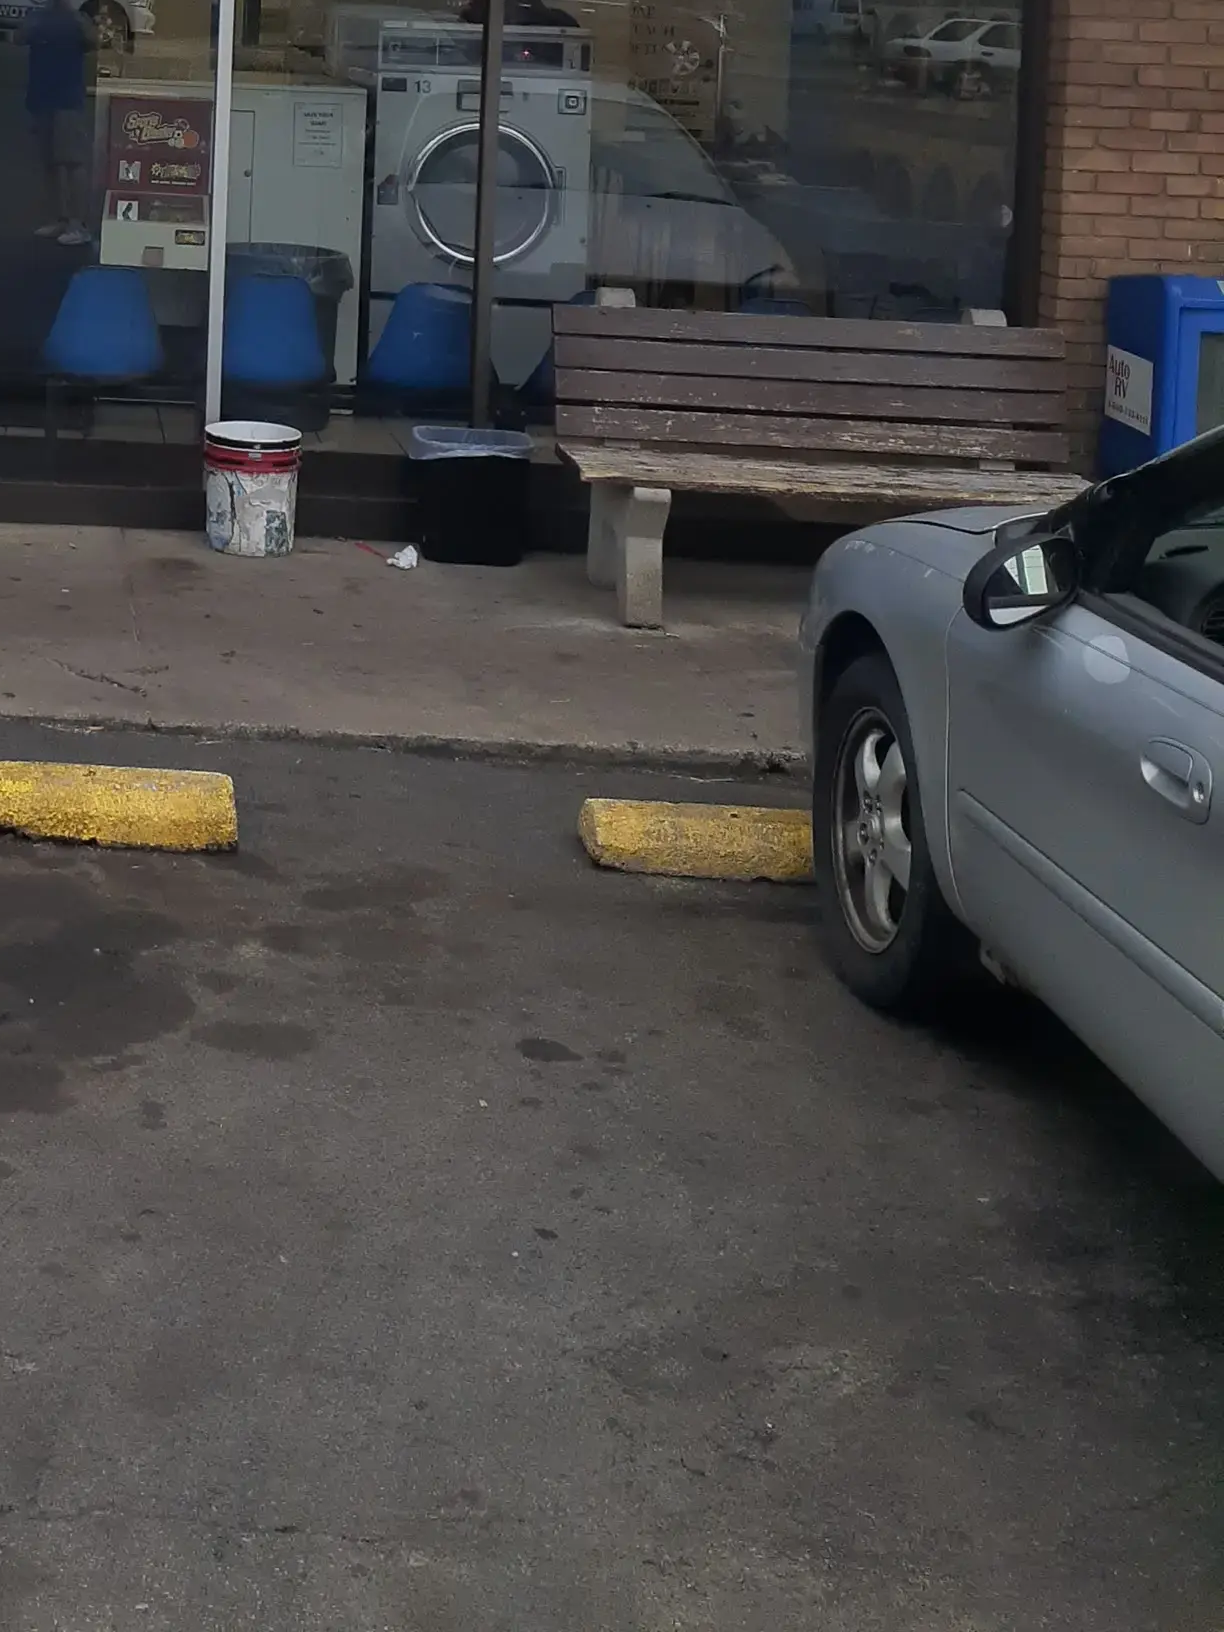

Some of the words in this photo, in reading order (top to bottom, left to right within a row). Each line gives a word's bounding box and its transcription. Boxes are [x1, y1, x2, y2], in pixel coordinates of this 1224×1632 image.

[413, 79, 432, 94] 13
[1109, 354, 1131, 380] Auto
[1114, 377, 1129, 399] RV
